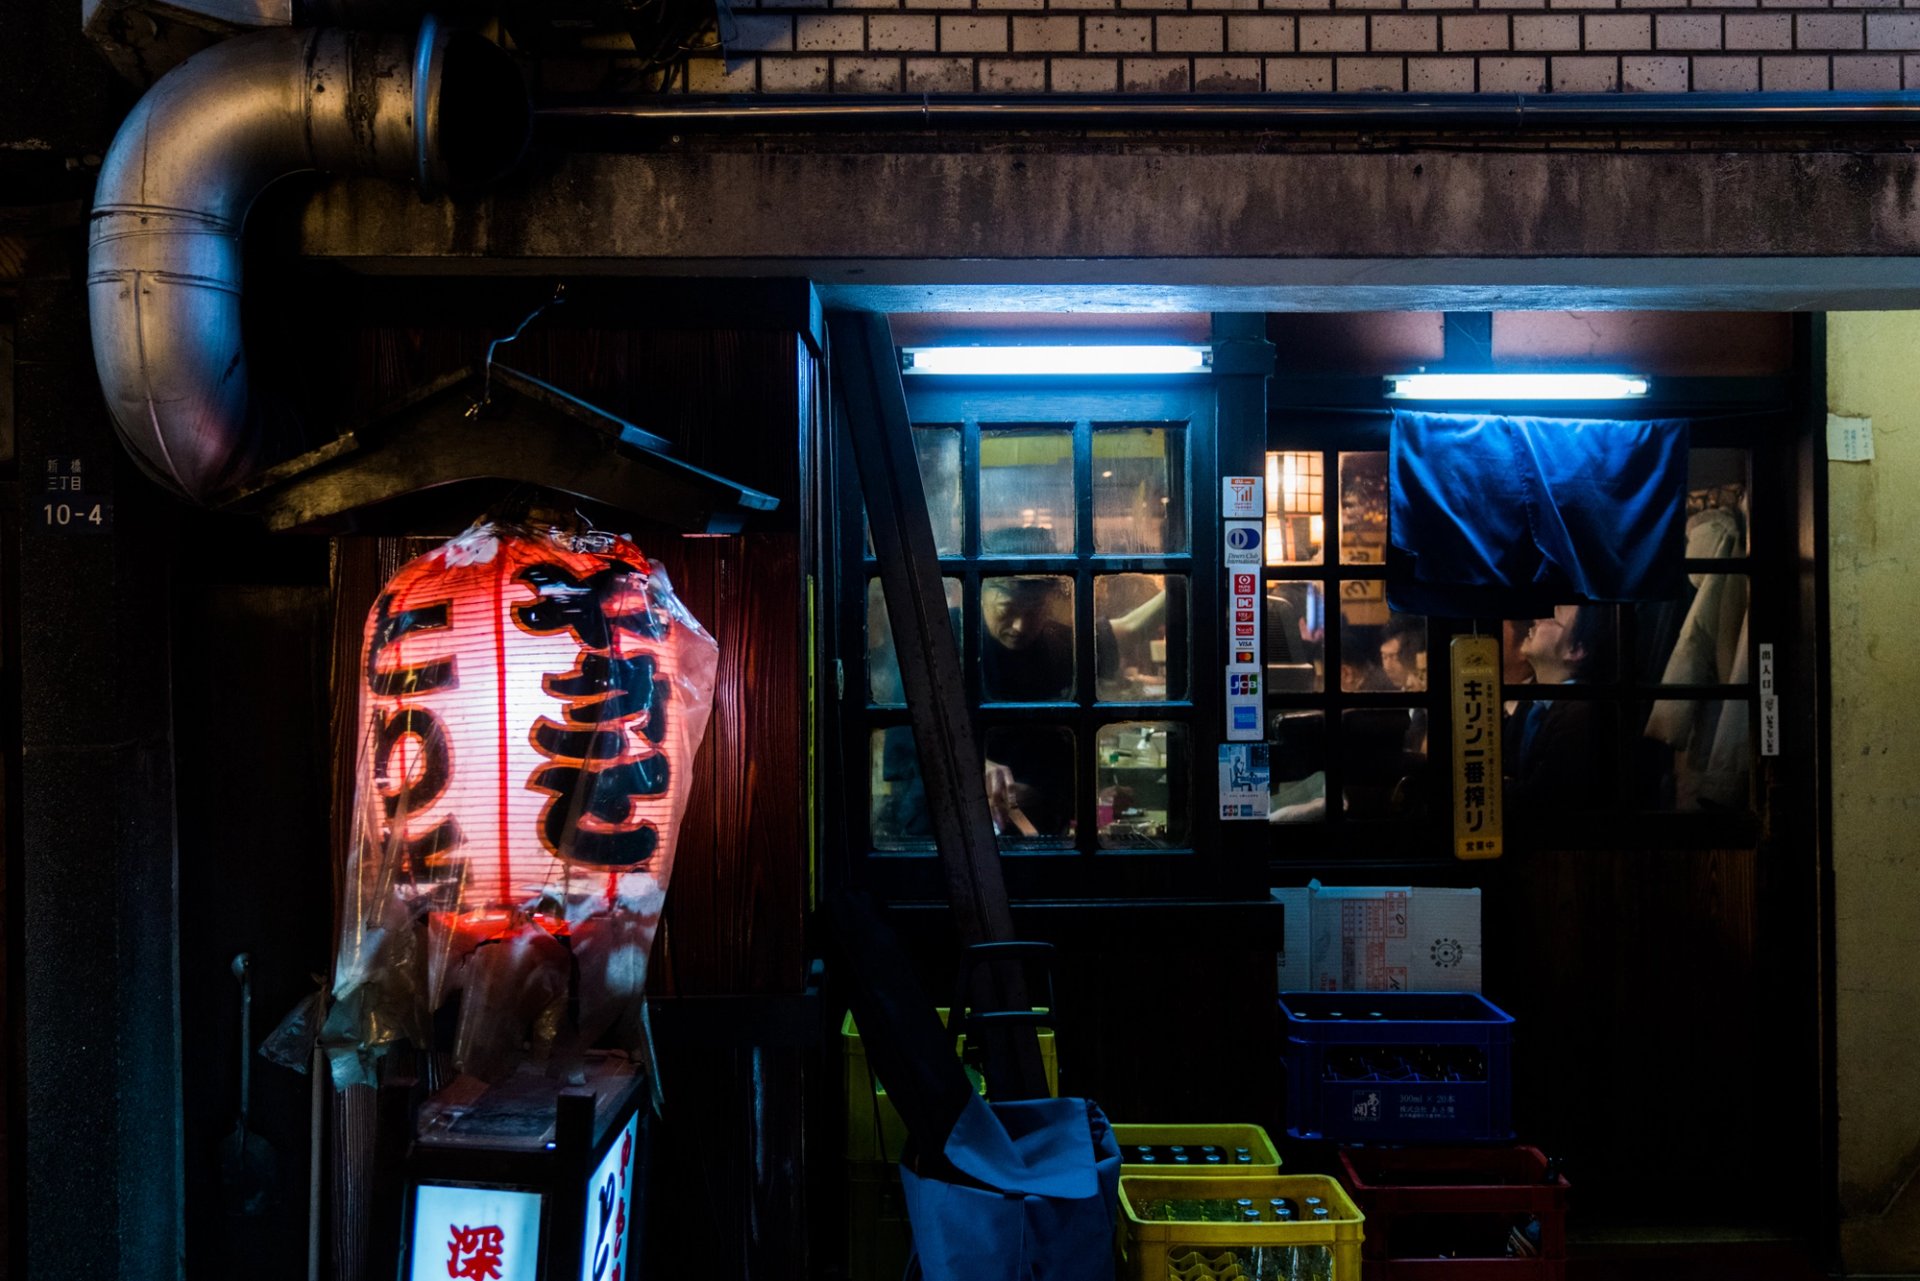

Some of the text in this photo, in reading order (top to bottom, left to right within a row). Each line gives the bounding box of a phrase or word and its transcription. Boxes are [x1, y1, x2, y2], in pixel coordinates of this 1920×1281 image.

[47, 475, 81, 491] 三丁目
[43, 503, 103, 526] 10-4
[1238, 598, 1252, 608] DC
[1464, 680, 1484, 832] キリン一番搾り
